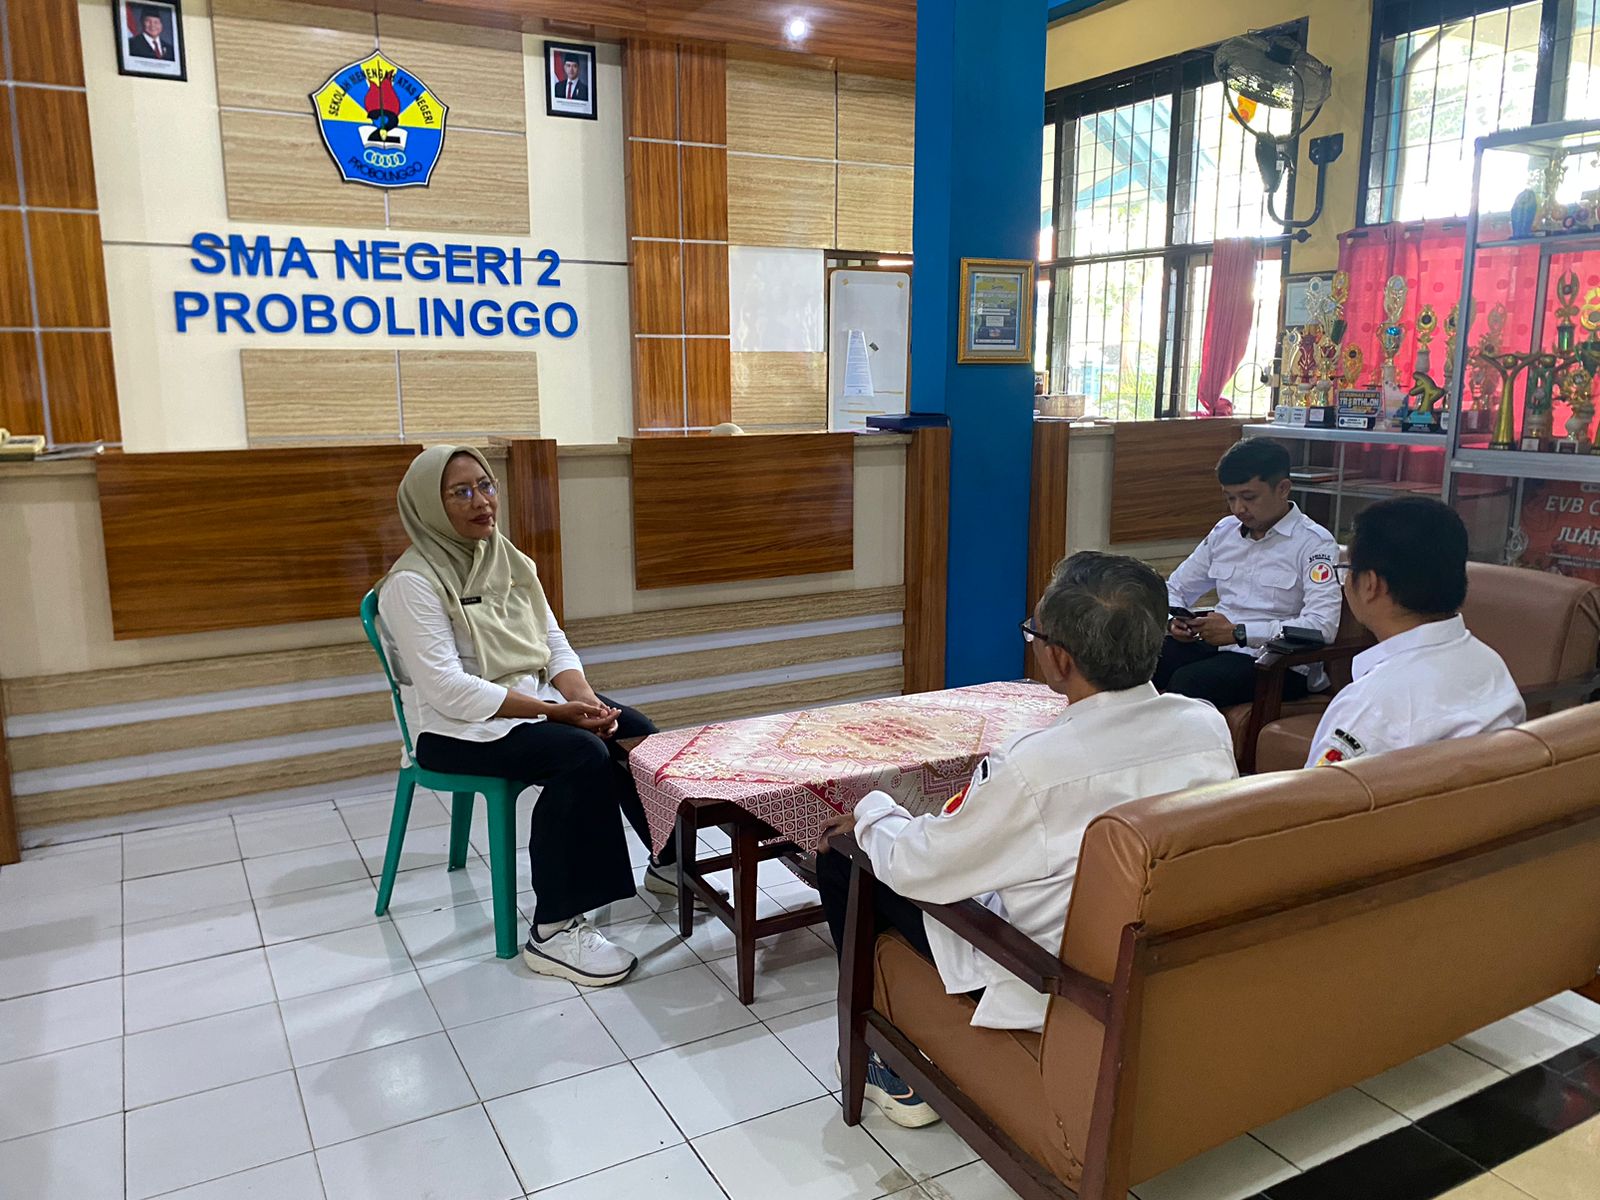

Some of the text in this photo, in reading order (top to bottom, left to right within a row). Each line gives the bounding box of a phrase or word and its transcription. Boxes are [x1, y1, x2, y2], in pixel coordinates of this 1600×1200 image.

[398, 77, 416, 96] ATAS
[414, 94, 434, 124] NEGERI
[349, 157, 422, 180] PROBOLINGGO
[191, 233, 561, 287] SMA NEGERI 2
[174, 291, 579, 337] PROBOLINGGO
[1546, 496, 1584, 513] EVB
